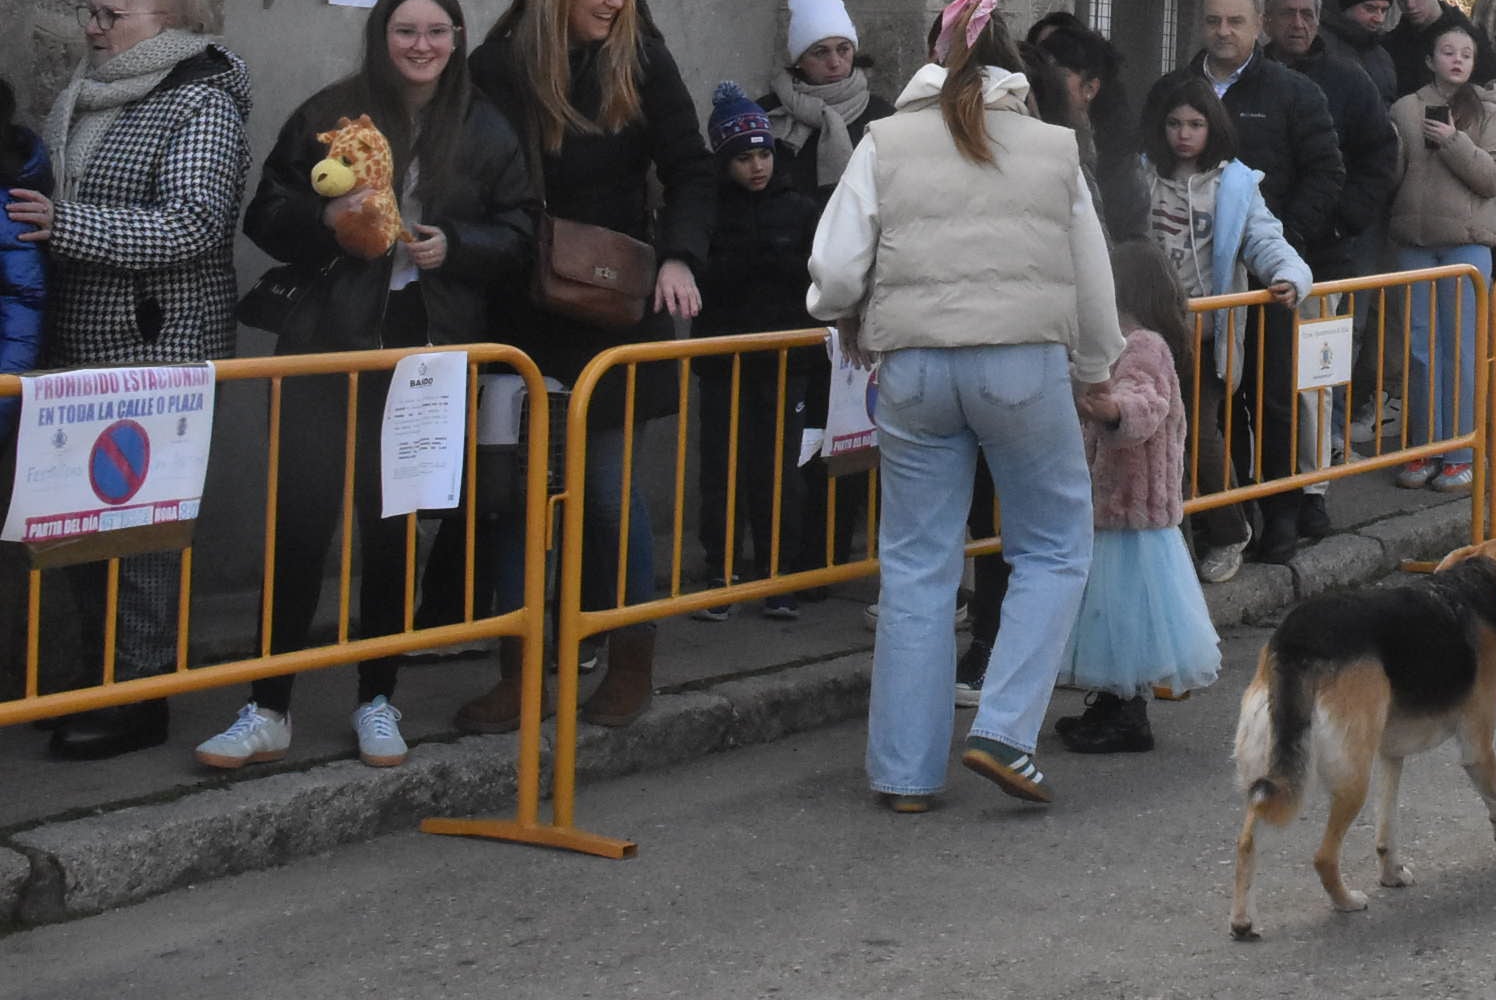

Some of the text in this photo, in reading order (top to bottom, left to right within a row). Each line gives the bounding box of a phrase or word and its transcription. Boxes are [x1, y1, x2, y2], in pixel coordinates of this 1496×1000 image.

[34, 367, 209, 400] PROHIBIDO ESTACIONAR
[38, 394, 203, 426] EN TODA LA CALLE O PLAZA
[29, 520, 63, 538] PARTIR
[64, 518, 81, 534] DEL
